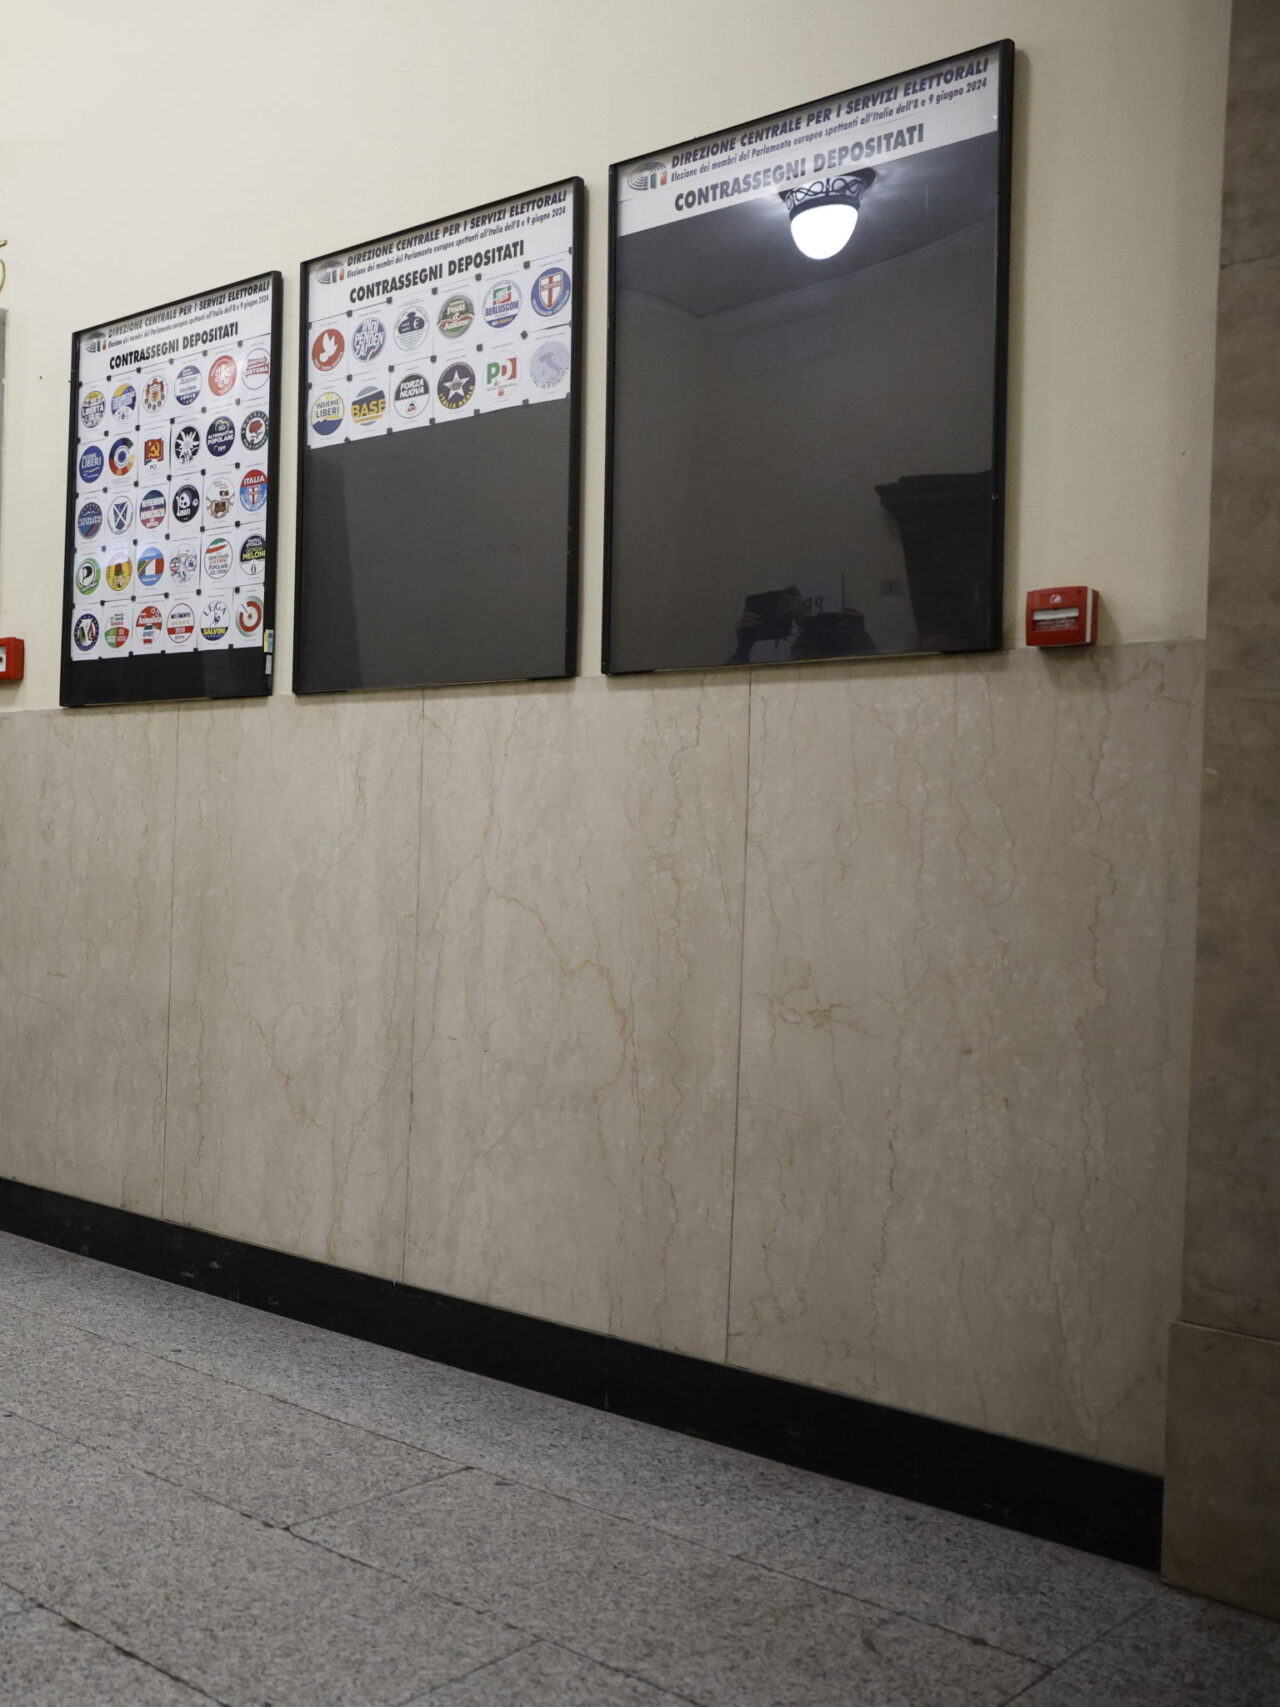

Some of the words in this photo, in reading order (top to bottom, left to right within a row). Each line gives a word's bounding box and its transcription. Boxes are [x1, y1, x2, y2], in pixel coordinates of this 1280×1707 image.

[671, 137, 736, 168] DIREZIONE
[741, 116, 802, 147] CENTRALE
[806, 107, 832, 127] PER
[836, 104, 841, 118] I
[846, 86, 898, 115] SERVIZI
[904, 58, 989, 97] ELETTORALI
[671, 168, 697, 182] Elezione
[700, 162, 710, 173] dei
[712, 155, 737, 170] membri
[739, 150, 750, 162] del
[752, 139, 791, 158] Parlamento
[794, 129, 822, 145] europeo
[825, 115, 858, 137] spettanti
[861, 106, 894, 125] all'Italia
[896, 100, 919, 115] dell'8
[921, 99, 925, 107] e
[929, 94, 934, 105] 9
[936, 87, 963, 104] giugno
[966, 77, 987, 93] 2024
[675, 158, 806, 211] CONTRASSEGNI
[814, 123, 924, 173] DEPOSITATI
[347, 243, 393, 267] DIREZIONE
[396, 228, 439, 251] CENTRALE
[442, 222, 460, 238] PER
[463, 220, 467, 232] I
[470, 208, 507, 230] SERVIZI
[509, 190, 567, 218] ELETTORALI
[347, 267, 366, 278] Elezione
[367, 263, 375, 272] dei
[376, 258, 394, 270] membri
[395, 255, 403, 265] del
[404, 246, 433, 261] Parlamento
[456, 232, 479, 247] spettanti
[531, 212, 550, 226] giugno
[551, 206, 566, 218] 2024
[350, 263, 443, 303] CONTRASSEGNI
[448, 239, 524, 276] DEPOSITATI
[108, 320, 143, 338] DIREZIONE
[144, 308, 177, 327] CENTRALE
[179, 304, 193, 318] PER
[199, 293, 226, 311] SERVIZI
[227, 280, 270, 302] ELETTORALI
[485, 300, 520, 317] BERLUSCONI
[110, 338, 179, 370] CONTRASSEGNI
[182, 321, 238, 350] DEPOSITATI
[315, 398, 339, 409] INSIEME
[352, 399, 386, 418] BASE
[400, 379, 424, 390] FORZA
[400, 386, 425, 399] NUOVA
[315, 406, 340, 418] LIBERI
[243, 475, 265, 485] ITALIA
